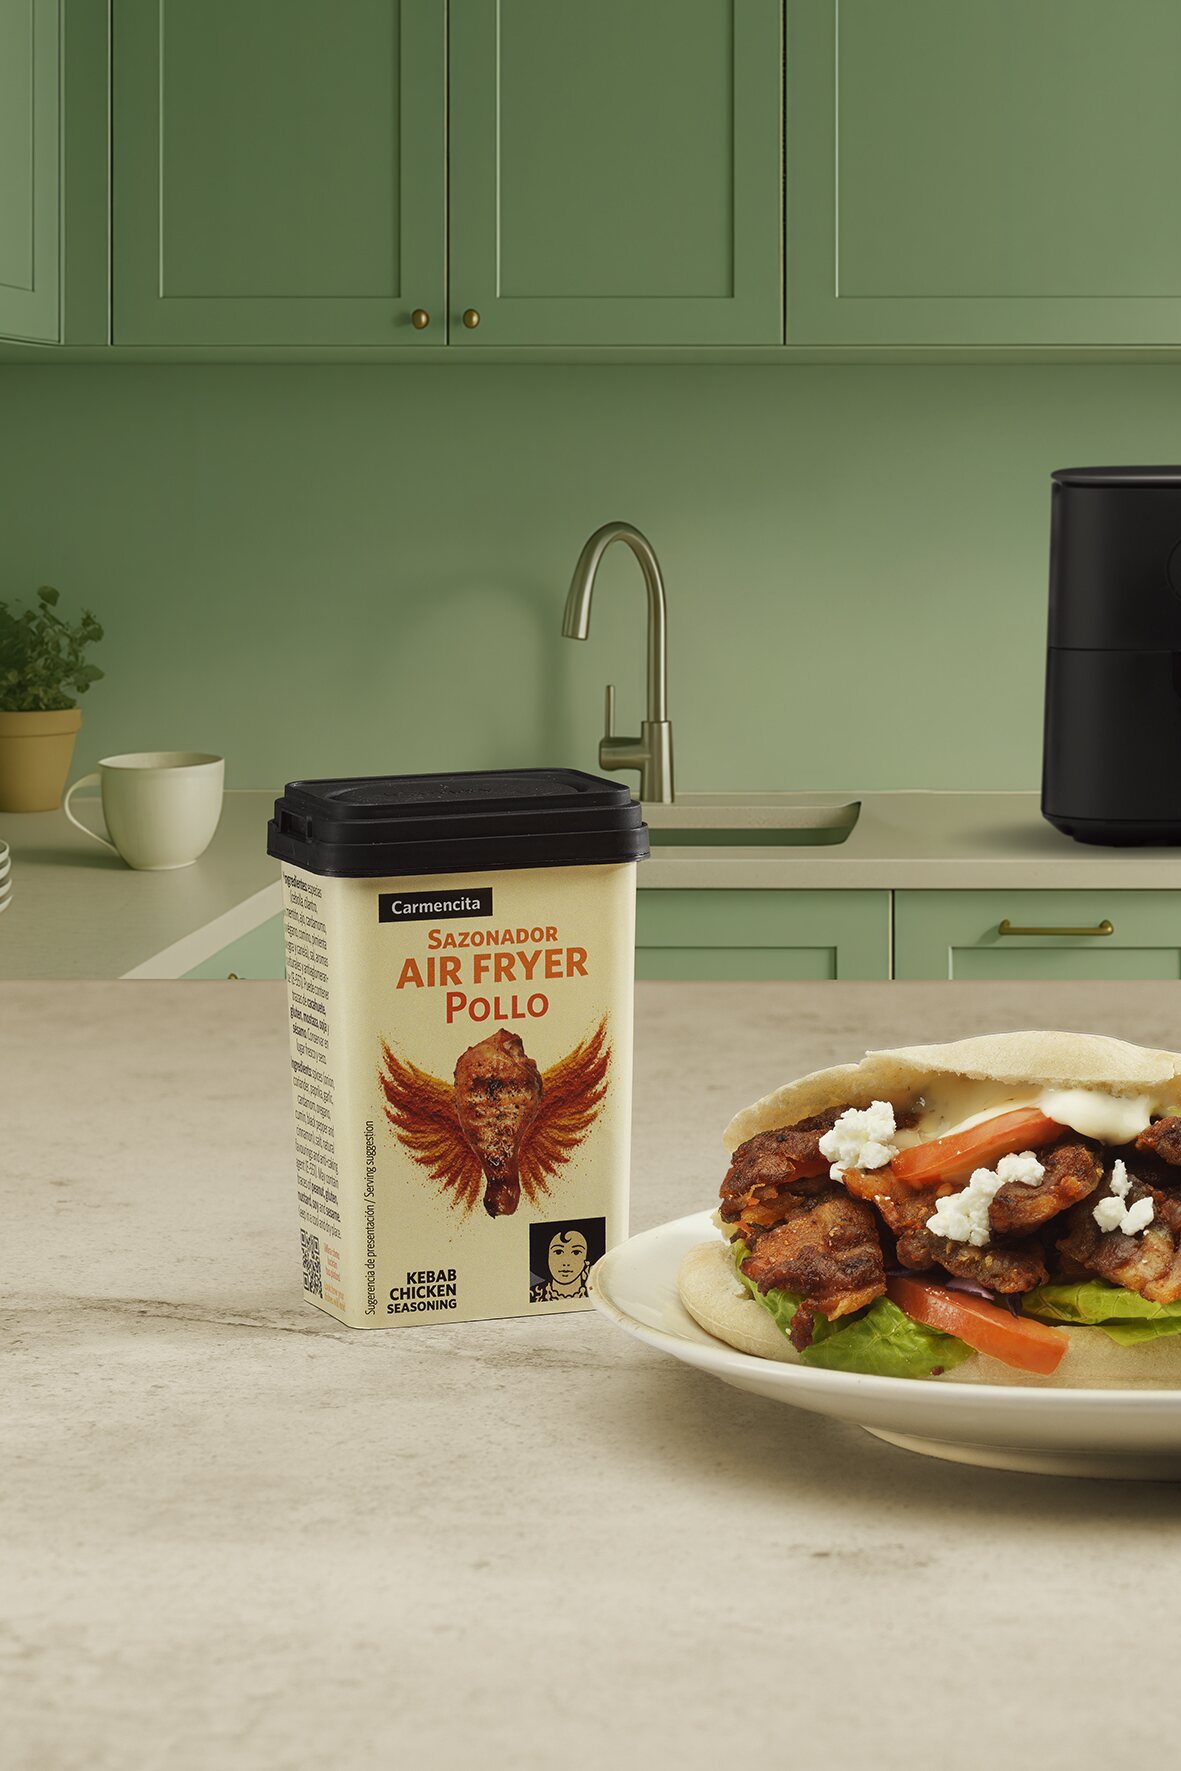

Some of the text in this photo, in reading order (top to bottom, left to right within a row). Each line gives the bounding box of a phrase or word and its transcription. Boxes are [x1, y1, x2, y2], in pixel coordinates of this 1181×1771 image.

[391, 897, 481, 914] Carmencita
[396, 947, 589, 989] AIR FRYER
[364, 1120, 376, 1163] suggestion
[364, 1164, 376, 1197] Serving
[364, 1209, 377, 1257] presentación
[365, 1256, 375, 1265] de
[407, 1269, 457, 1285] KEBAB
[365, 1266, 378, 1315] Sugerencia
[390, 1284, 457, 1300] CHICKEN
[387, 1299, 457, 1314] SEASONING
